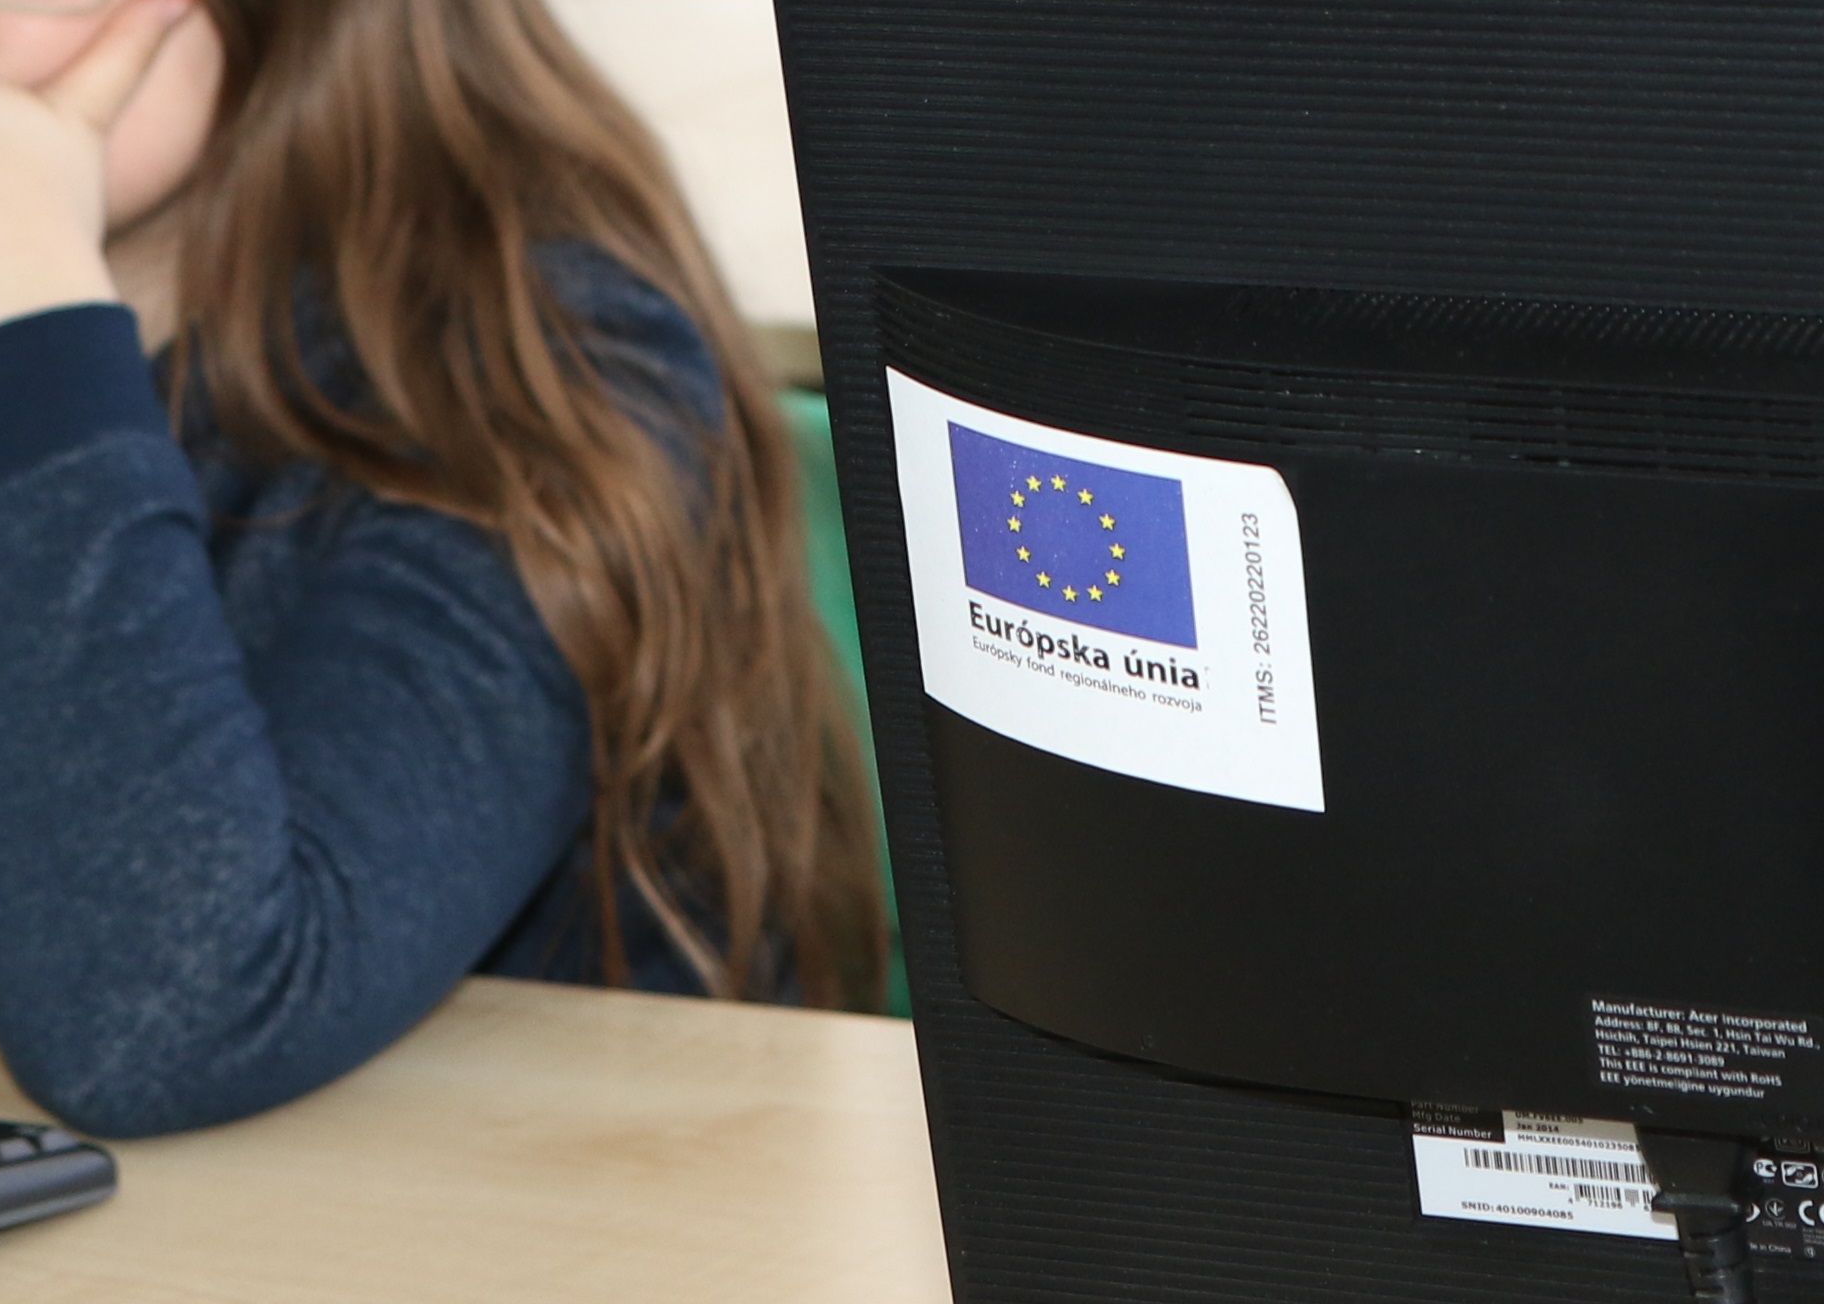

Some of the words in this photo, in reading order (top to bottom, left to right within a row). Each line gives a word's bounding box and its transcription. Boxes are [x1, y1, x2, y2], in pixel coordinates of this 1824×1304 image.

[1241, 512, 1271, 655] 26220220123
[968, 599, 1110, 670] Európska
[1123, 649, 1200, 690] únia
[972, 635, 1023, 668] Európsky
[1026, 655, 1055, 677] fond
[1060, 667, 1147, 700] regionálneho
[1152, 692, 1203, 713] rozvoja
[1255, 661, 1277, 725] ITMS:
[1592, 999, 1685, 1021] Manufacturer:
[1689, 1009, 1718, 1024] Acer
[1595, 1016, 1644, 1031] Address:
[1725, 1029, 1752, 1042] Hsin
[1754, 1031, 1773, 1044] Tai
[1774, 1034, 1796, 1047] Wu
[1595, 1029, 1641, 1045] Hsichih,
[1642, 1033, 1678, 1048] Taipei
[1680, 1038, 1713, 1051] Hsien
[1716, 1040, 1740, 1055] 221,
[1743, 1044, 1787, 1059] Taiwan
[1599, 1057, 1623, 1070] This
[1625, 1060, 1646, 1072] EEE
[1649, 1062, 1659, 1074] is
[1661, 1065, 1719, 1081] compliant
[1721, 1070, 1748, 1083] with
[1750, 1073, 1783, 1087] RoHS
[1600, 1070, 1621, 1084] EEE
[1708, 1084, 1766, 1099] uygundur
[1413, 1110, 1432, 1122] Mfg
[1435, 1112, 1461, 1124] Date
[1517, 1122, 1533, 1131] Jan
[1536, 1123, 1560, 1134] 2014
[1413, 1122, 1447, 1135] Serial
[1448, 1125, 1492, 1139] Number
